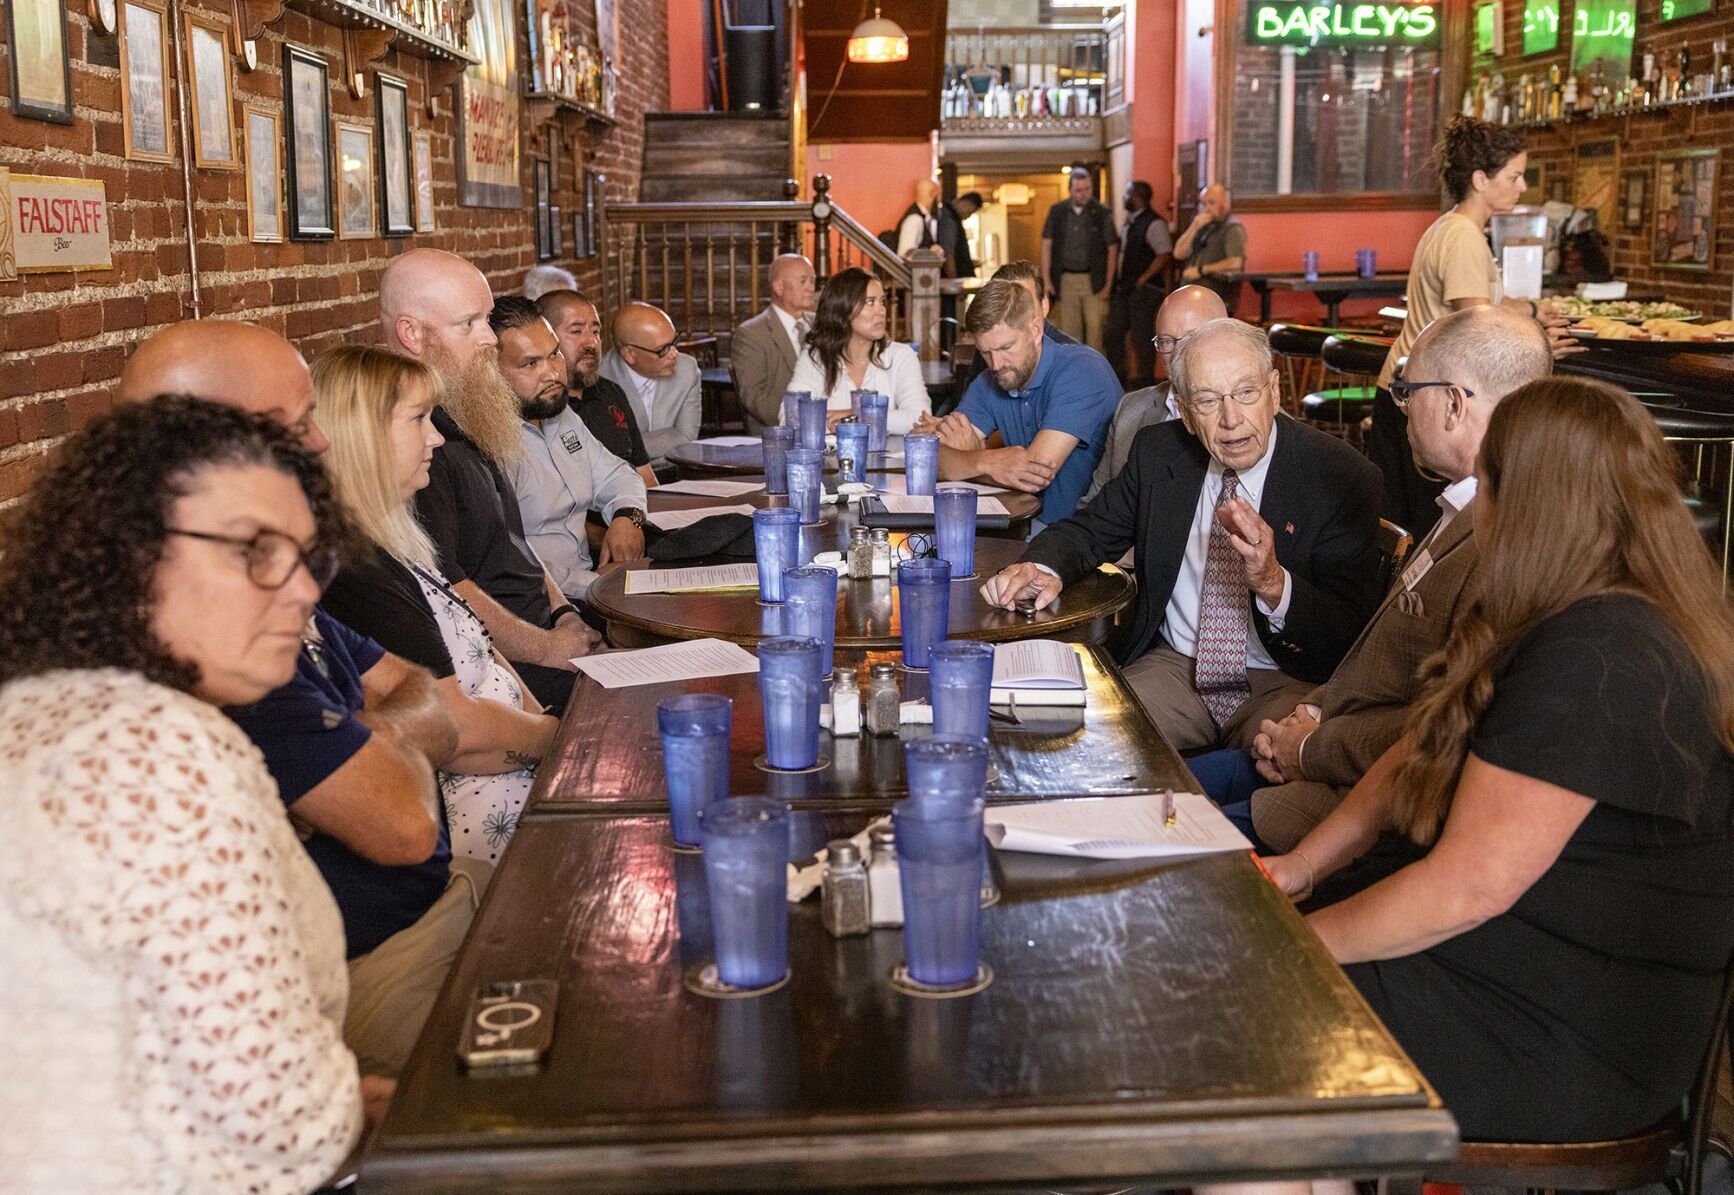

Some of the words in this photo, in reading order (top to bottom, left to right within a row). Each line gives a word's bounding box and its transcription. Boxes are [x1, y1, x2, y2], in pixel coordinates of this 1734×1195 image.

[1257, 3, 1437, 38] BARLEY'S
[17, 196, 102, 234] FALSTAFF
[53, 237, 72, 252] Beer
